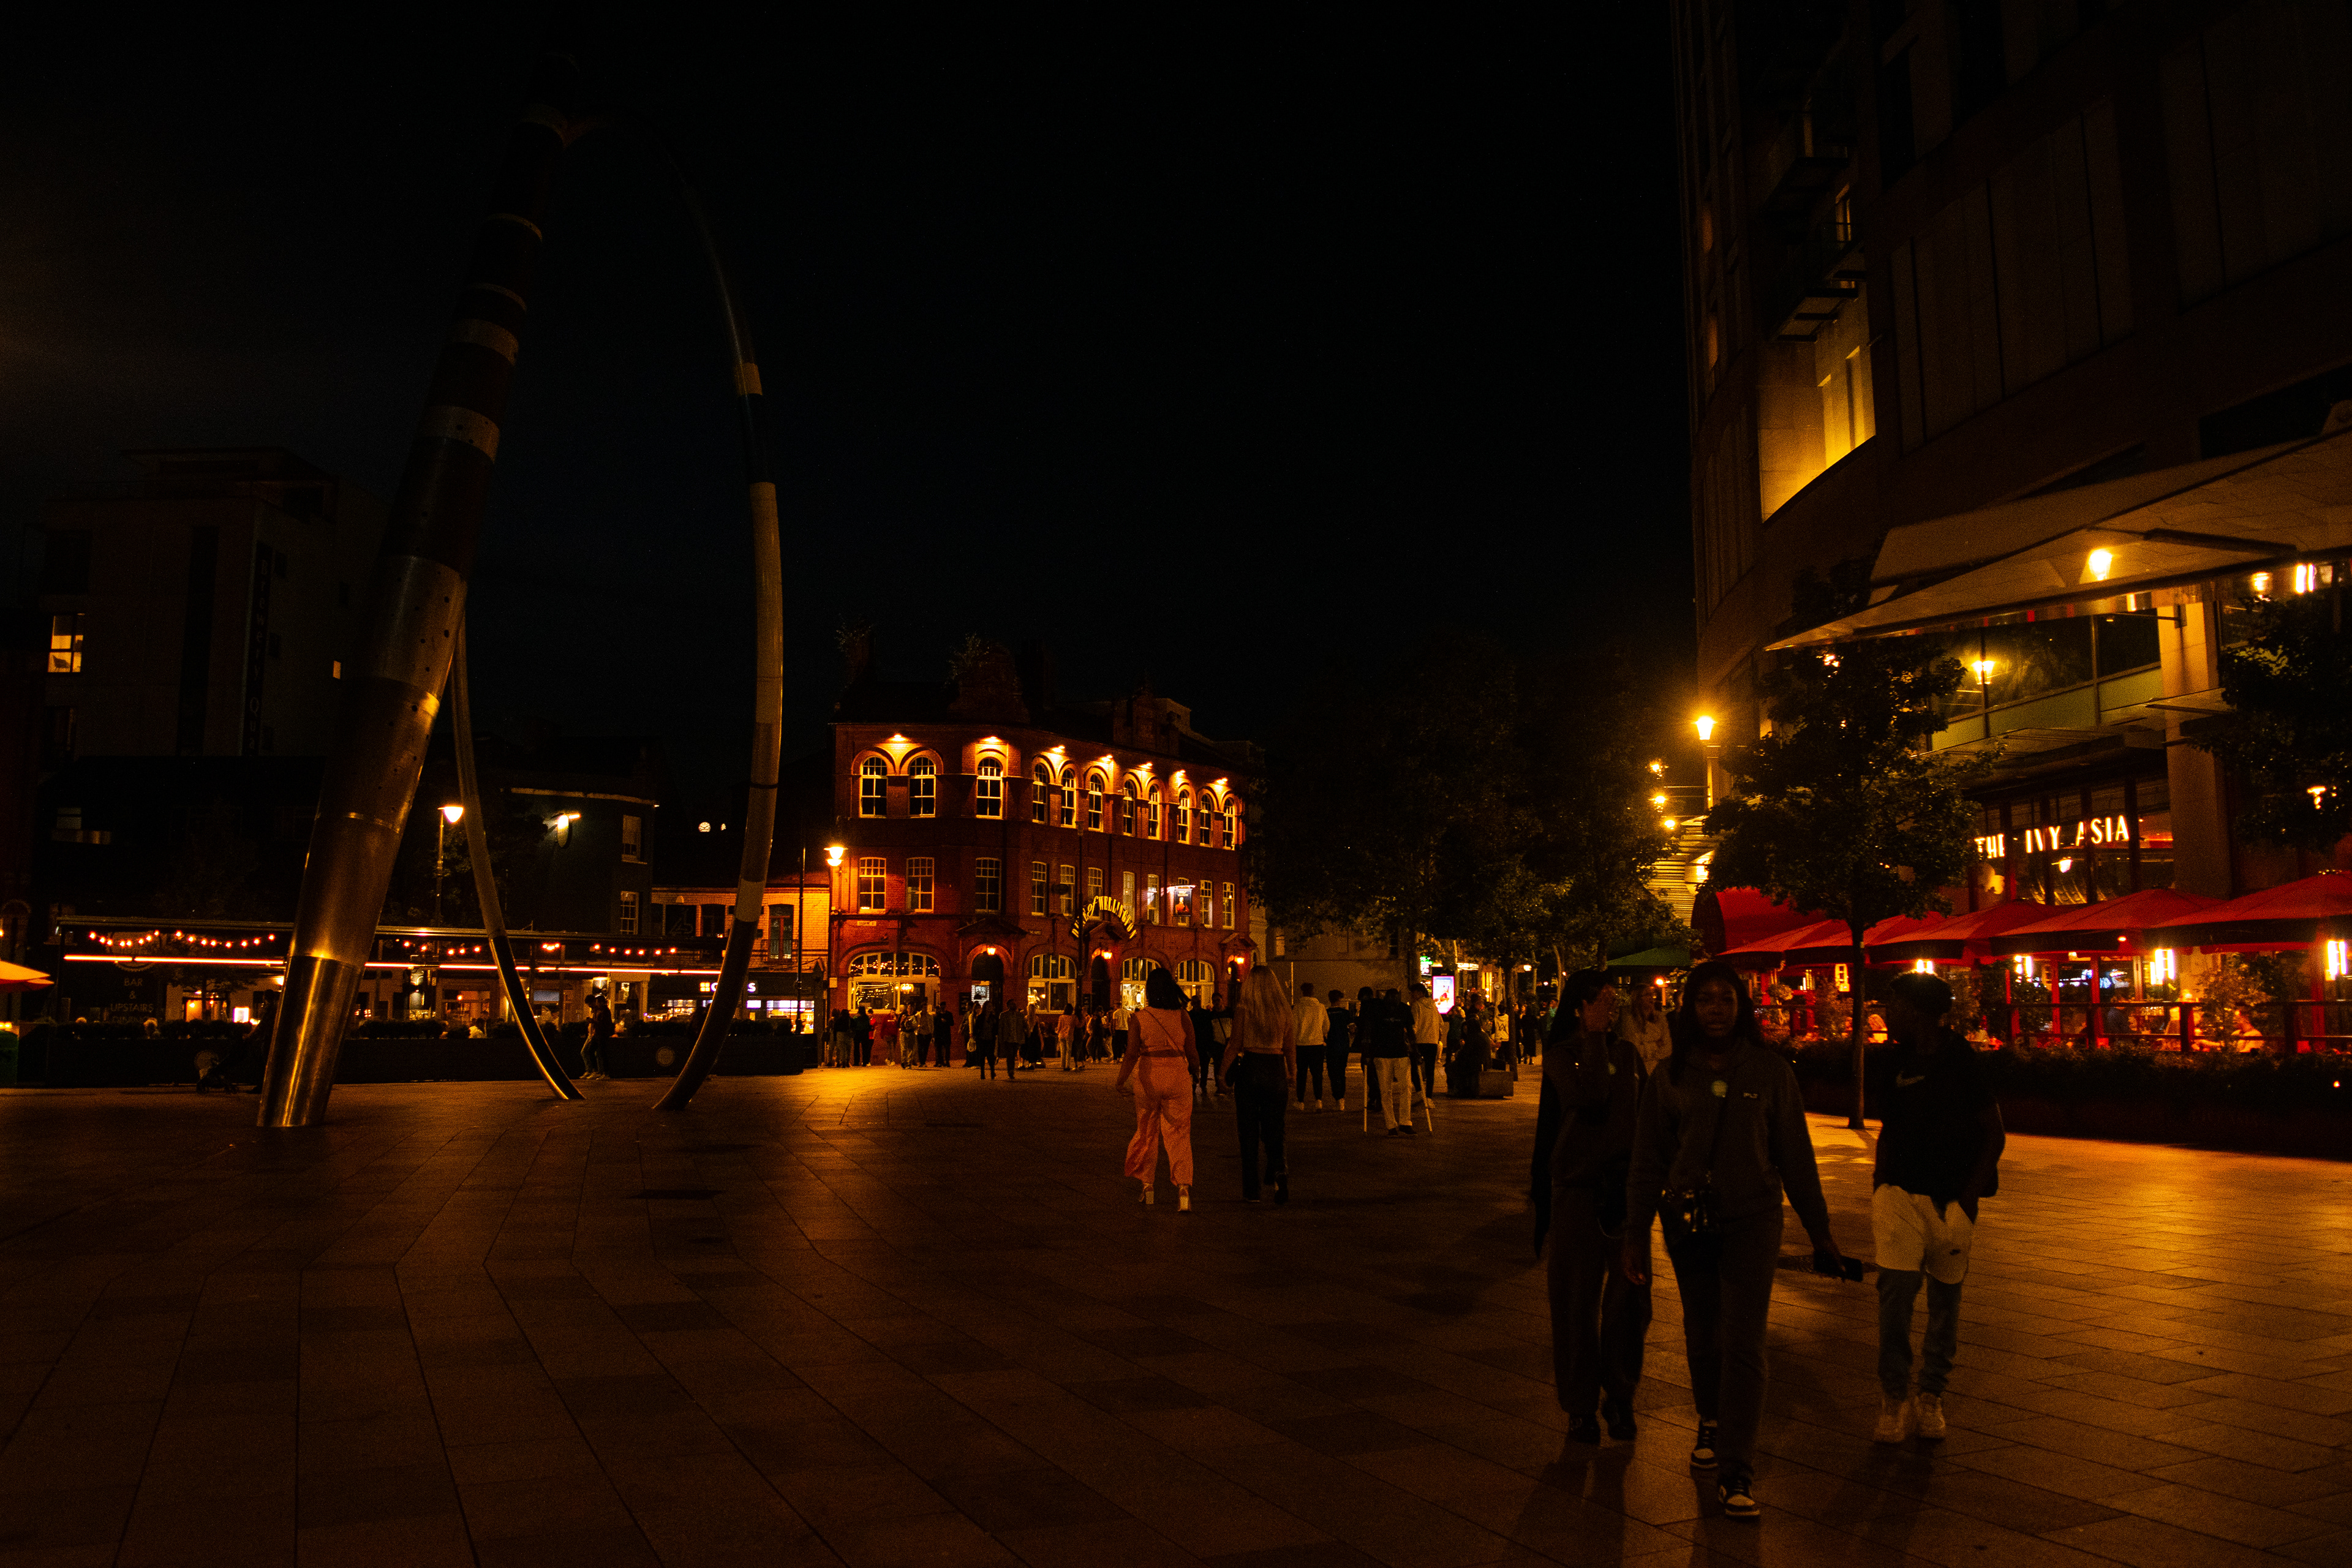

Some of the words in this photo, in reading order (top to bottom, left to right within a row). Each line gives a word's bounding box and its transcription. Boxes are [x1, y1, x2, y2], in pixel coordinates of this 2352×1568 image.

[253, 559, 268, 680] Brewery
[248, 696, 260, 753] Qua
[1973, 832, 2006, 859] THE
[2024, 825, 2061, 854] IVY
[2075, 814, 2130, 846] ASIA
[1087, 895, 1099, 918] of
[1098, 895, 1137, 939] WELLINGTON
[123, 977, 144, 987] BAR
[129, 990, 137, 1000] &
[110, 1003, 154, 1012] UPSTAIRS
